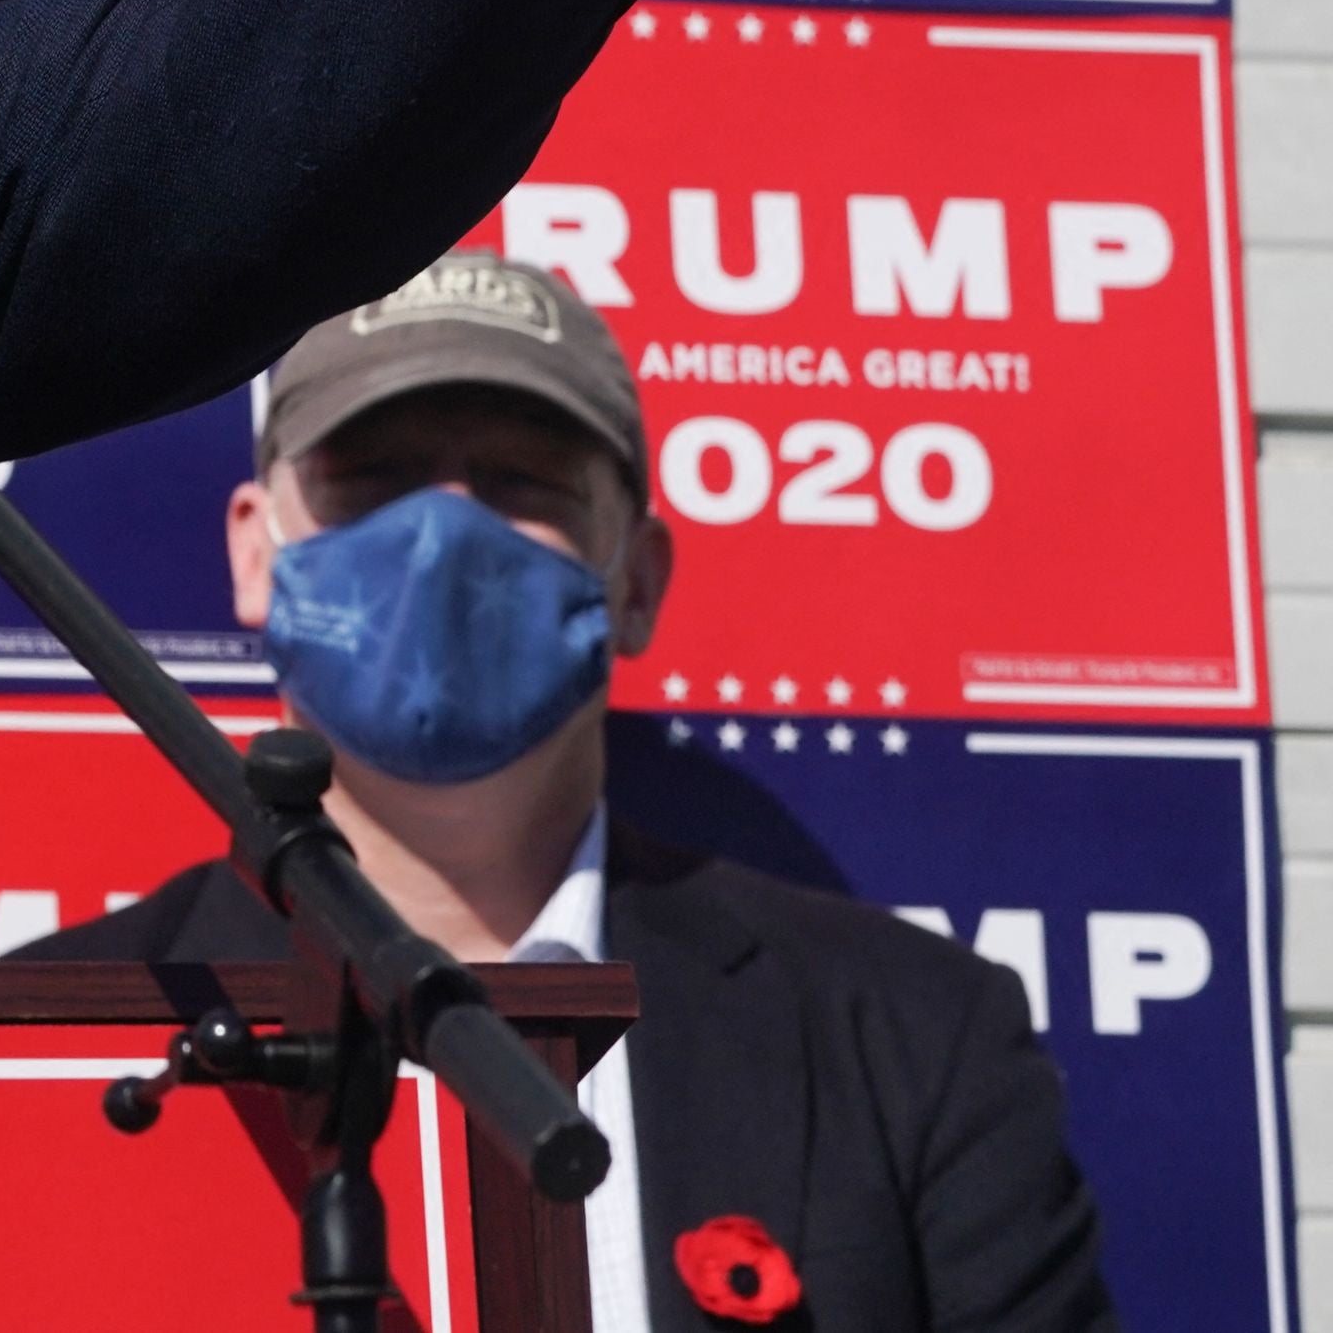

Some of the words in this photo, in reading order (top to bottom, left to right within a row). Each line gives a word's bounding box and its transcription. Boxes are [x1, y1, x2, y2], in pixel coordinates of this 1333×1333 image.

[501, 182, 1175, 324] RUMP
[638, 341, 851, 387] AMERICA
[862, 348, 1031, 393] GREAT!
[659, 415, 994, 532] 020
